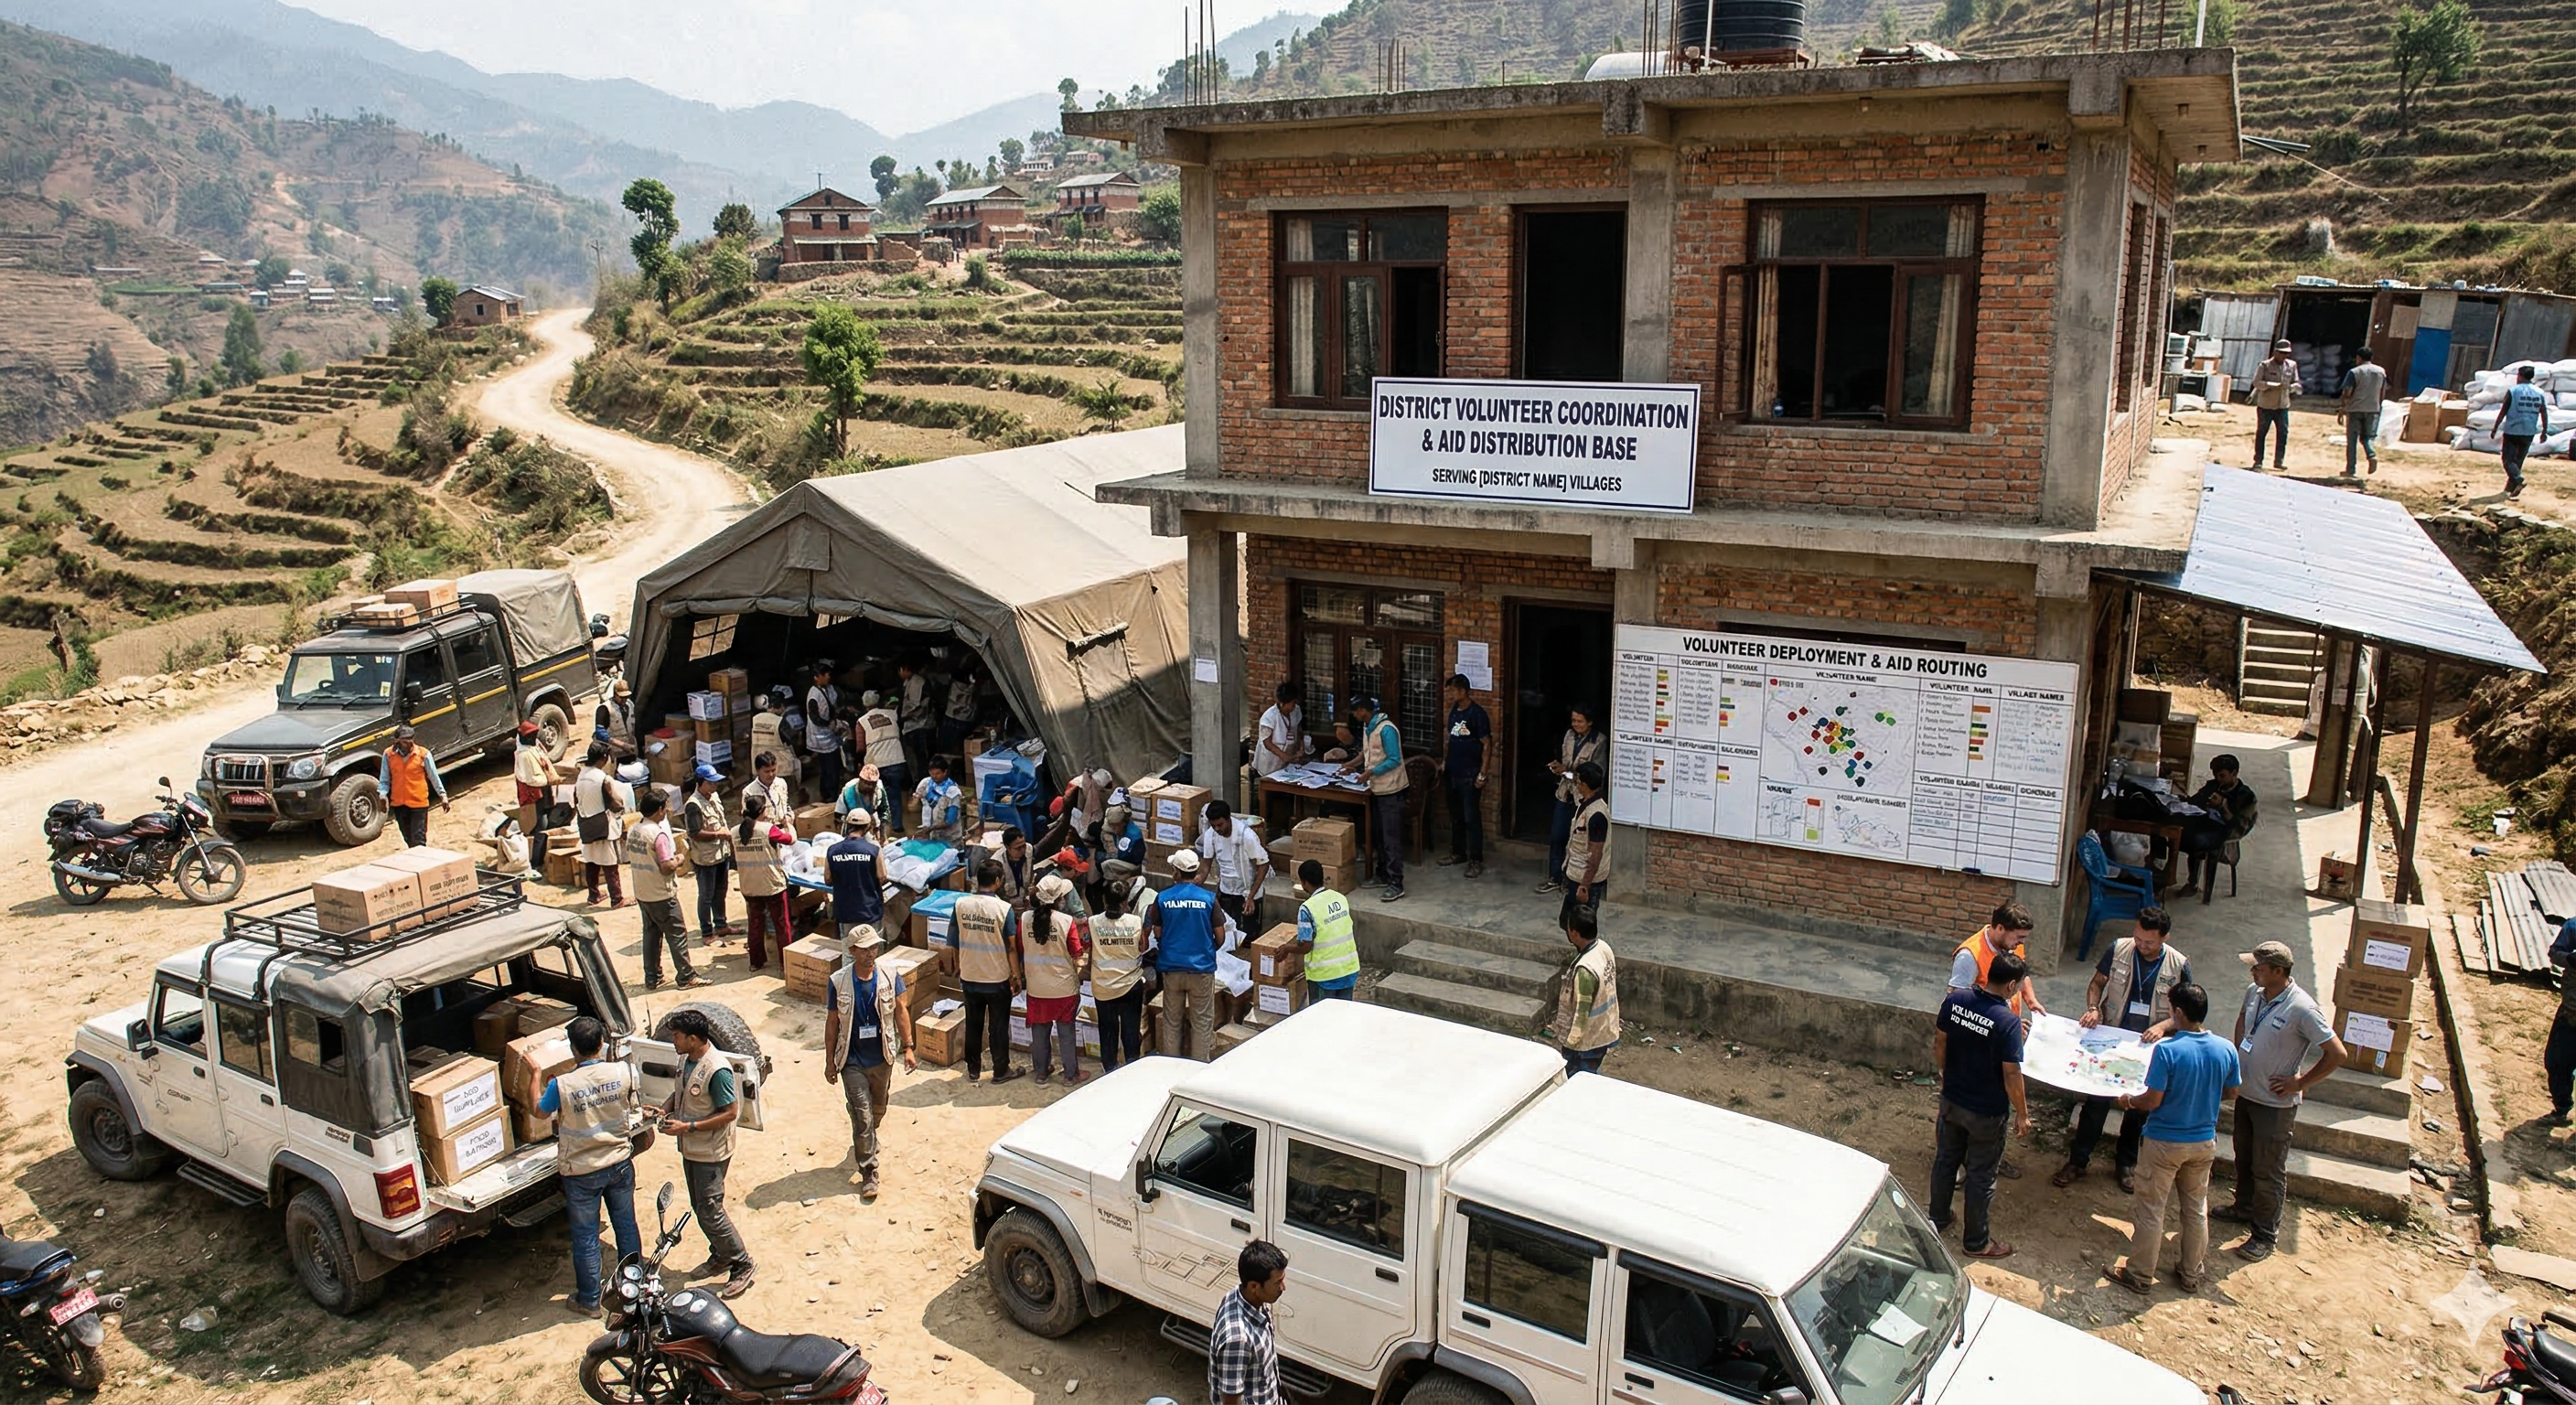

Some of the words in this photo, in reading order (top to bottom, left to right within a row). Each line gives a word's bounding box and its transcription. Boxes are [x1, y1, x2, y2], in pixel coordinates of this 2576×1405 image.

[1379, 395, 1452, 420] DISTRICT
[1455, 397, 1553, 424] VOLUNTEER
[1558, 401, 1689, 429] COORDINATION
[1422, 429, 1433, 452] &
[1438, 430, 1464, 453] AID
[1470, 431, 1587, 458] DISTRIBUTION
[1592, 436, 1637, 460] BASE
[1432, 468, 1477, 485] SERVING
[1479, 469, 1530, 488] [DISTRICT
[1532, 472, 1567, 492] NAME]
[1569, 475, 1622, 492] VILLAGES
[1682, 637, 1766, 658] VOLUNTEER
[1769, 644, 1867, 667] DEPLOYMENT
[1871, 654, 1882, 669] &
[1885, 655, 1912, 671] AID
[1917, 659, 1988, 679] ROUTING
